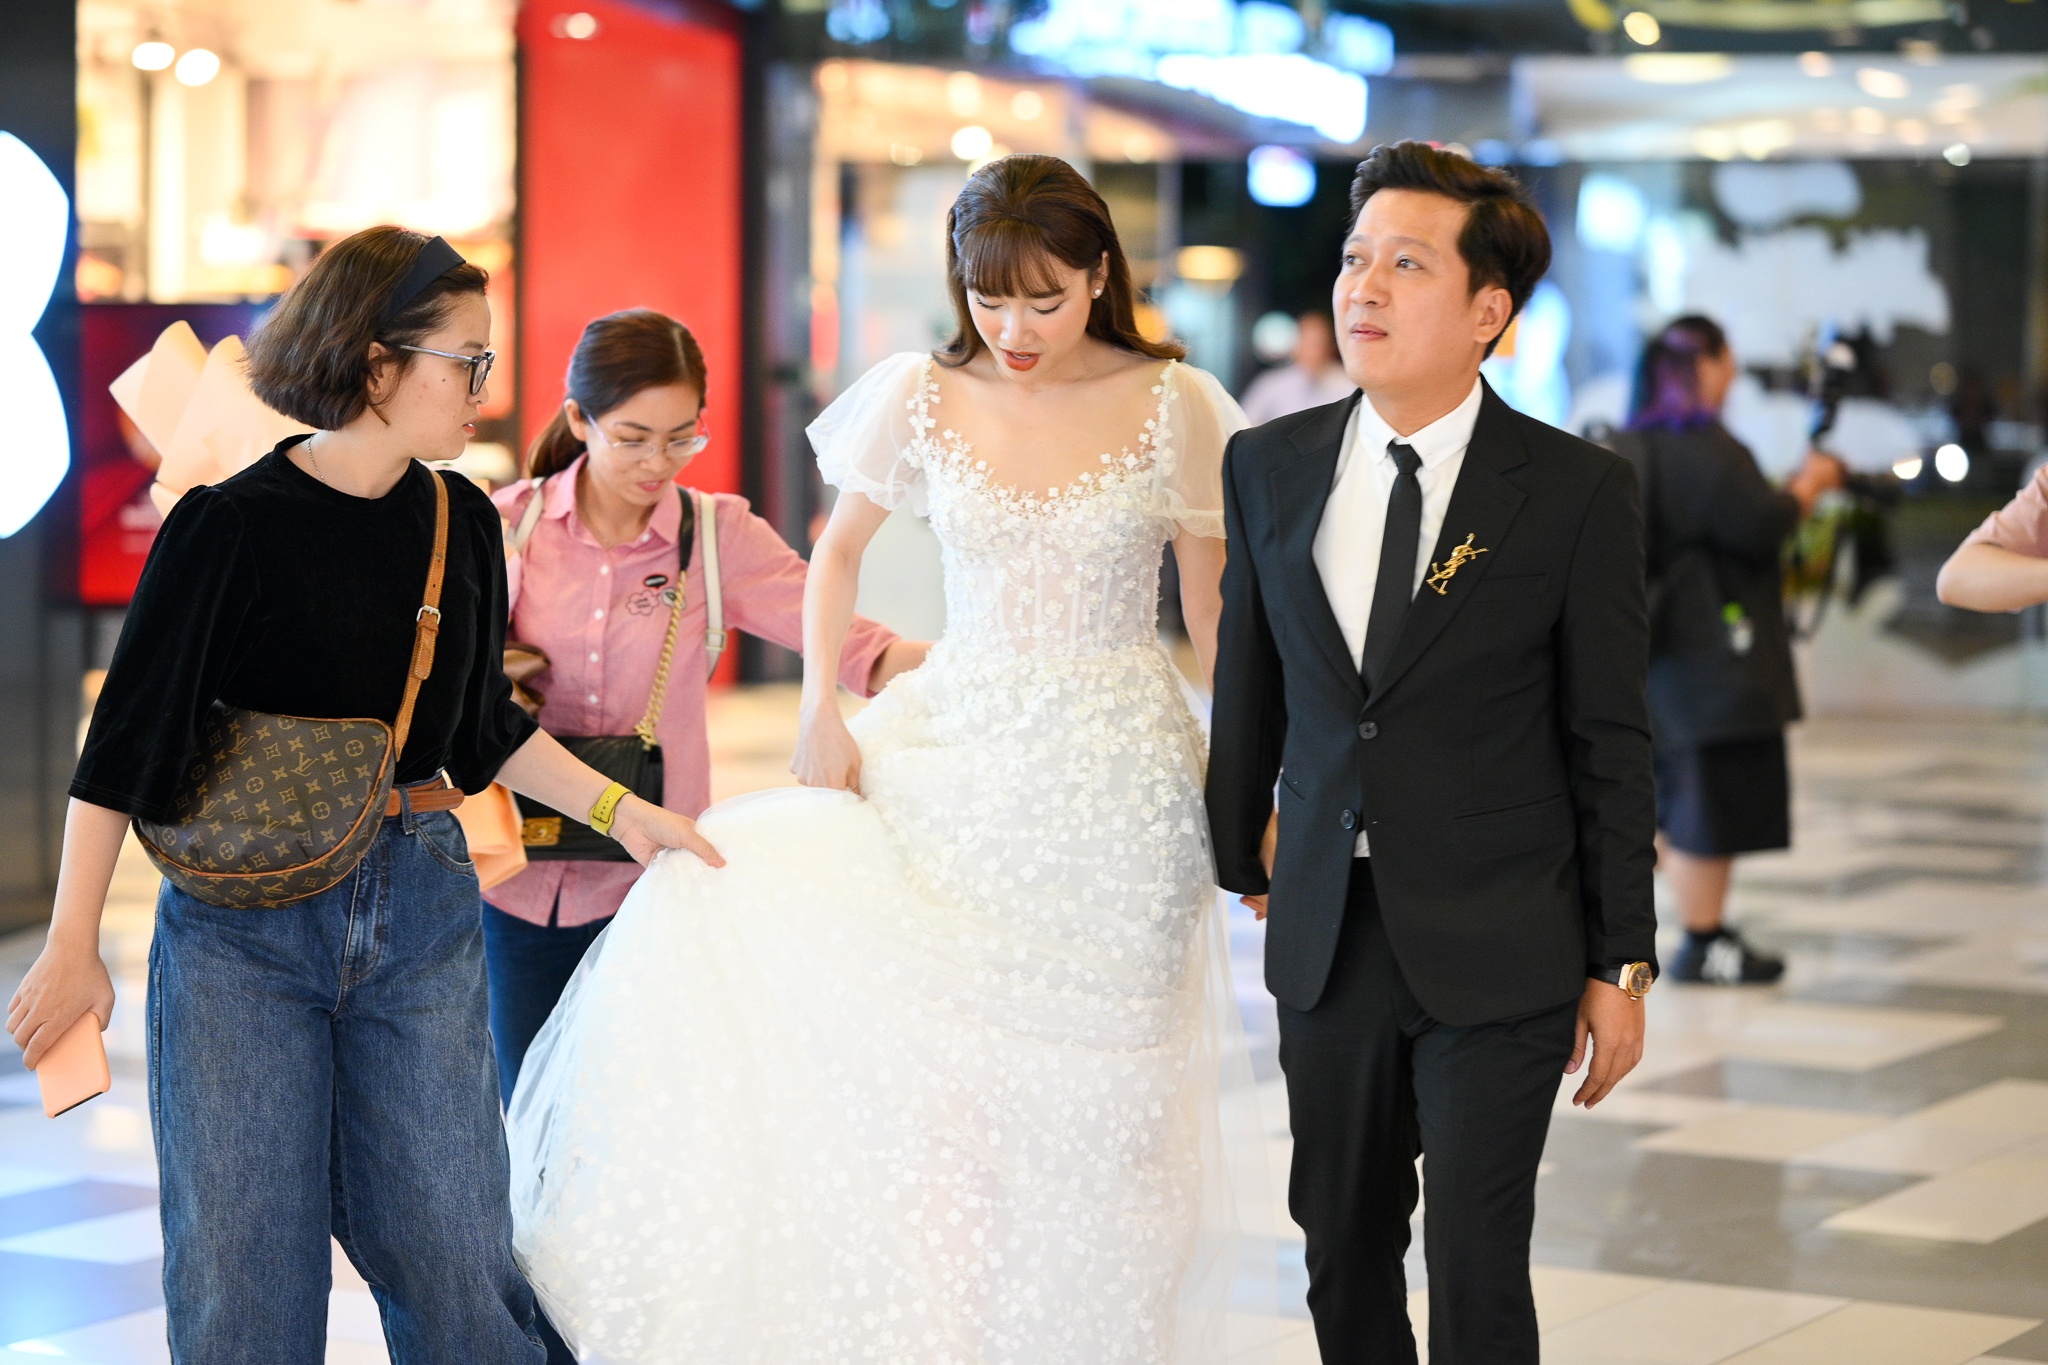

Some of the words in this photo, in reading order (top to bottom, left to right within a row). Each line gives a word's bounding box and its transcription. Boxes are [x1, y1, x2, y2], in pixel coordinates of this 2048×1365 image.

[290, 751, 320, 777] LV
[196, 795, 221, 819] LV
[257, 814, 287, 839] LV
